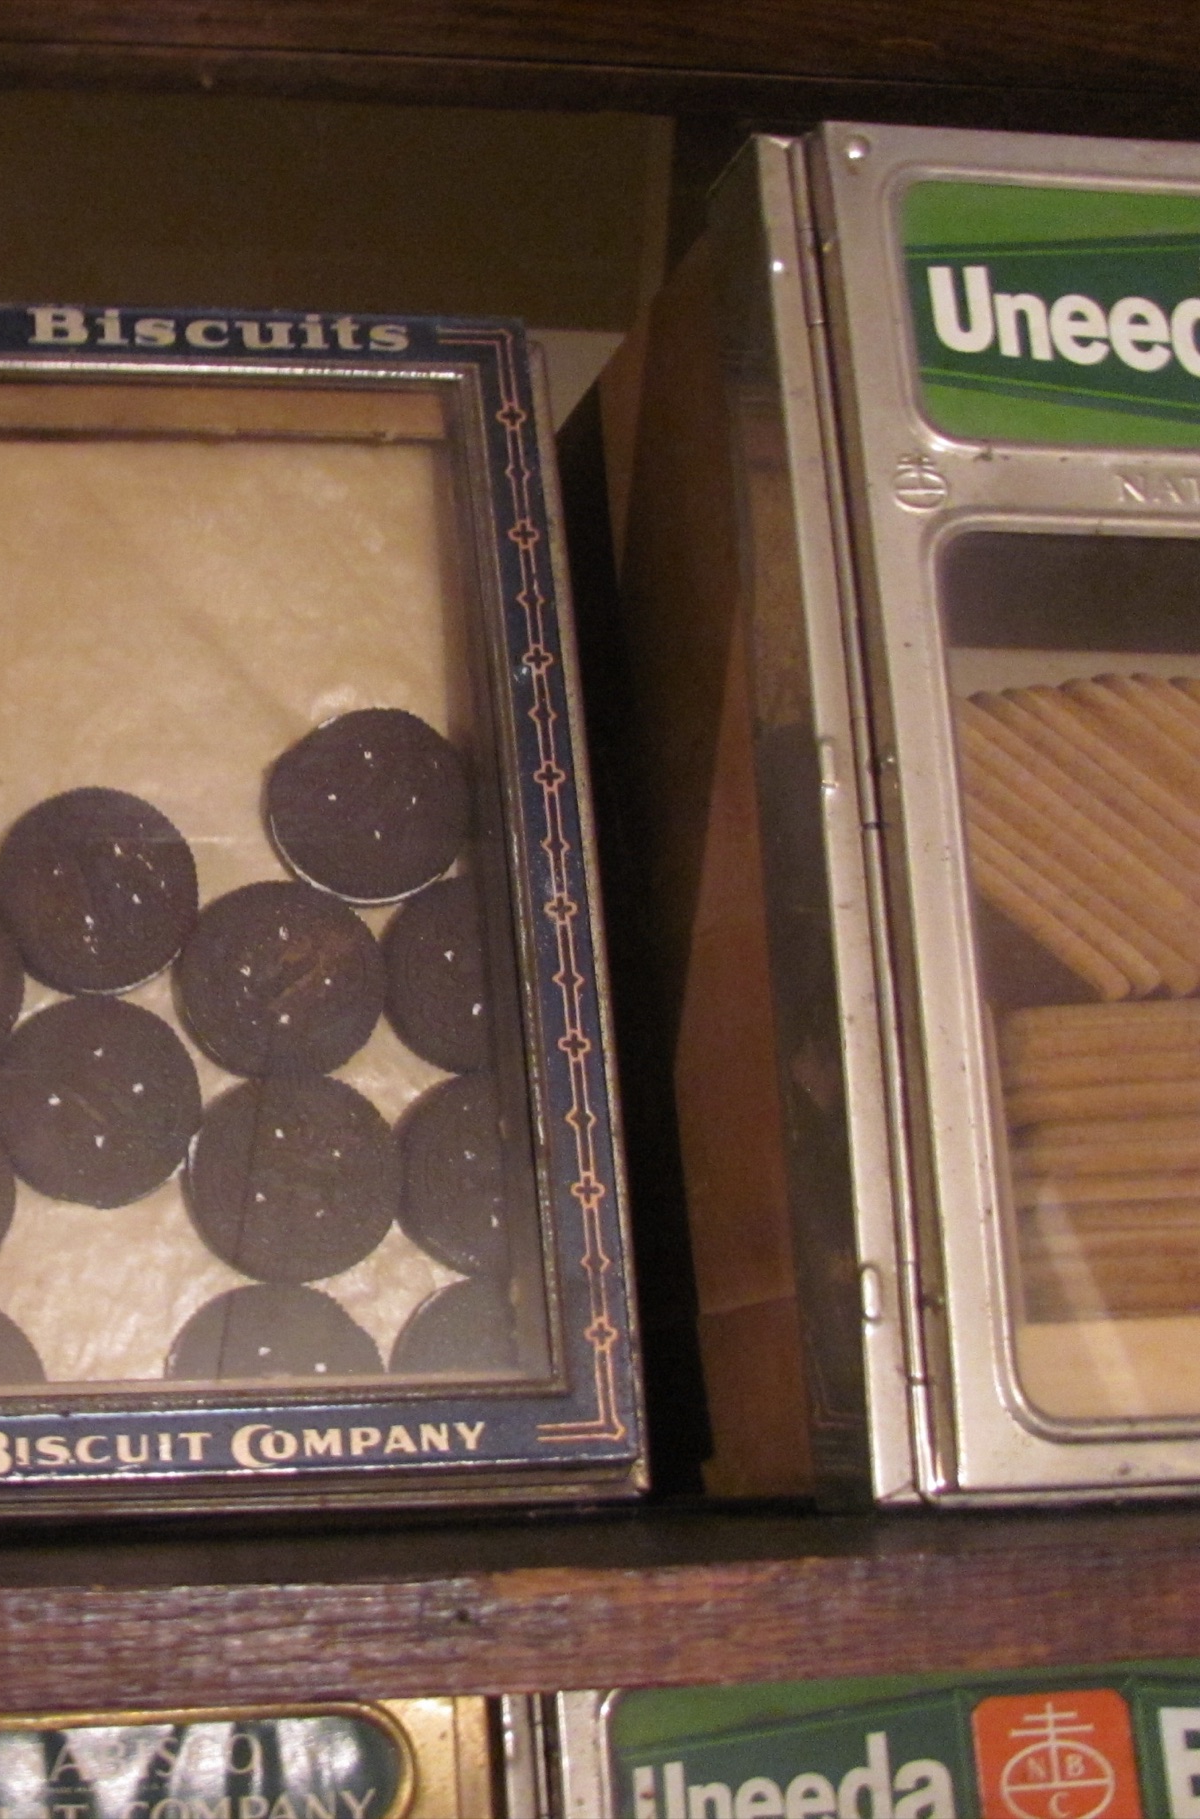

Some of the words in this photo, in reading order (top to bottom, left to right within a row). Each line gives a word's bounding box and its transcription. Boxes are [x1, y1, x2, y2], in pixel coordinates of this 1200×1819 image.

[27, 306, 410, 351] Biscuits
[231, 1421, 485, 1469] COMPANY
[1, 1733, 262, 1784] ABISCO
[633, 1731, 956, 1819] Uneeda
